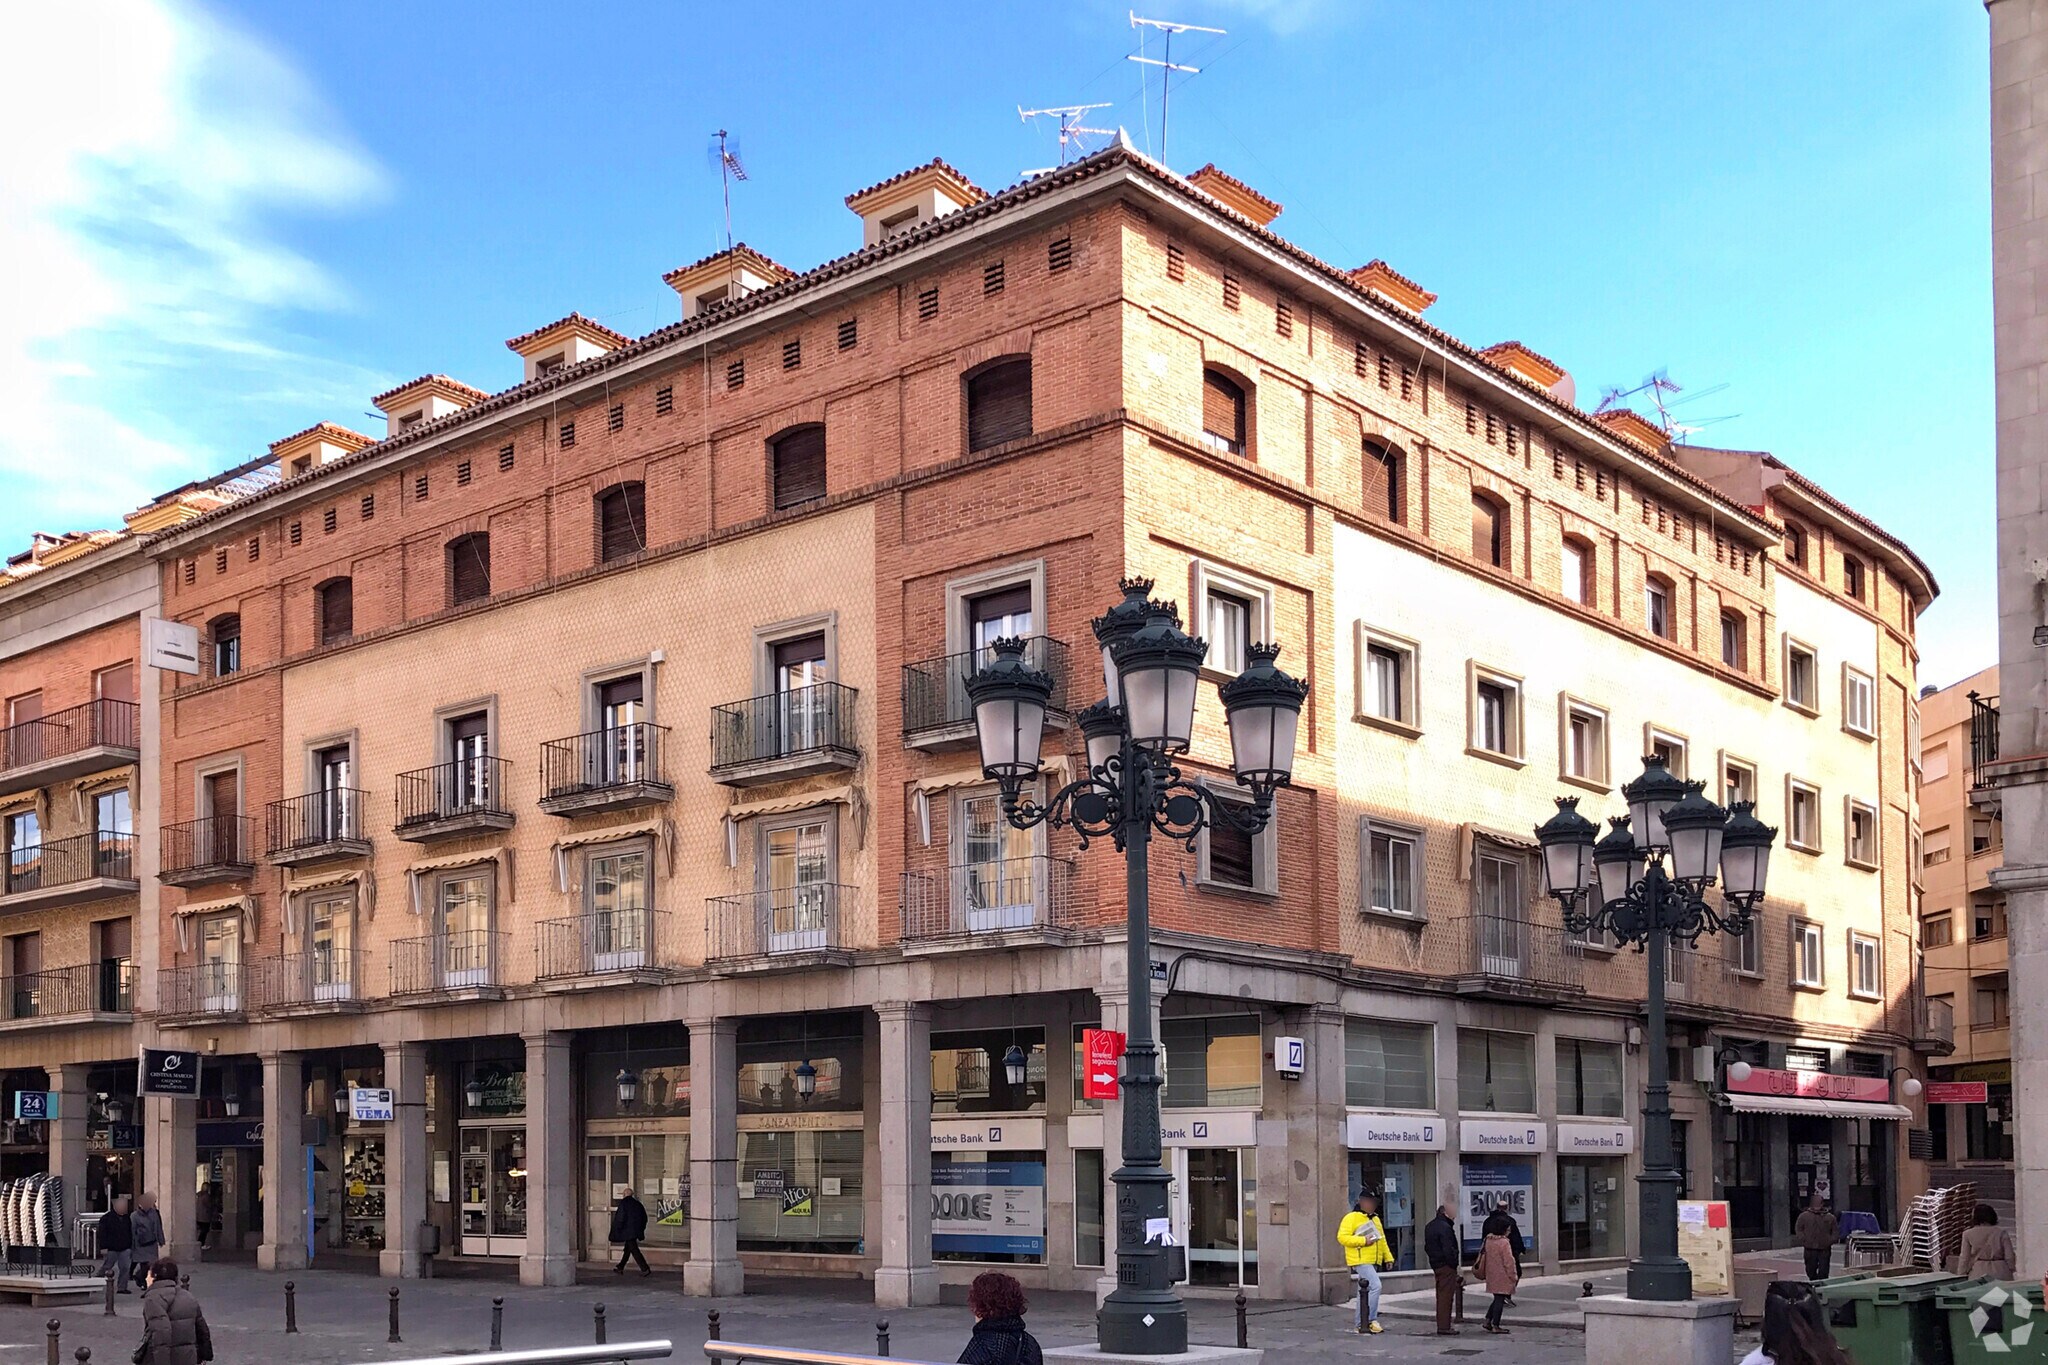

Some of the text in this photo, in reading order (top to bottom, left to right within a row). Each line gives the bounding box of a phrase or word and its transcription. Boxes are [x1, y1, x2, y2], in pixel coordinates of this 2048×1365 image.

[23, 1098, 40, 1108] 24
[356, 1109, 392, 1119] VEMA
[116, 1131, 129, 1139] 24
[961, 1133, 984, 1143] Bank
[1161, 1128, 1186, 1138] Bank
[1368, 1130, 1420, 1142] Deutsche Bank
[1479, 1134, 1524, 1144] Deutsche Bank
[1574, 1136, 1613, 1146] Deutsche Bank
